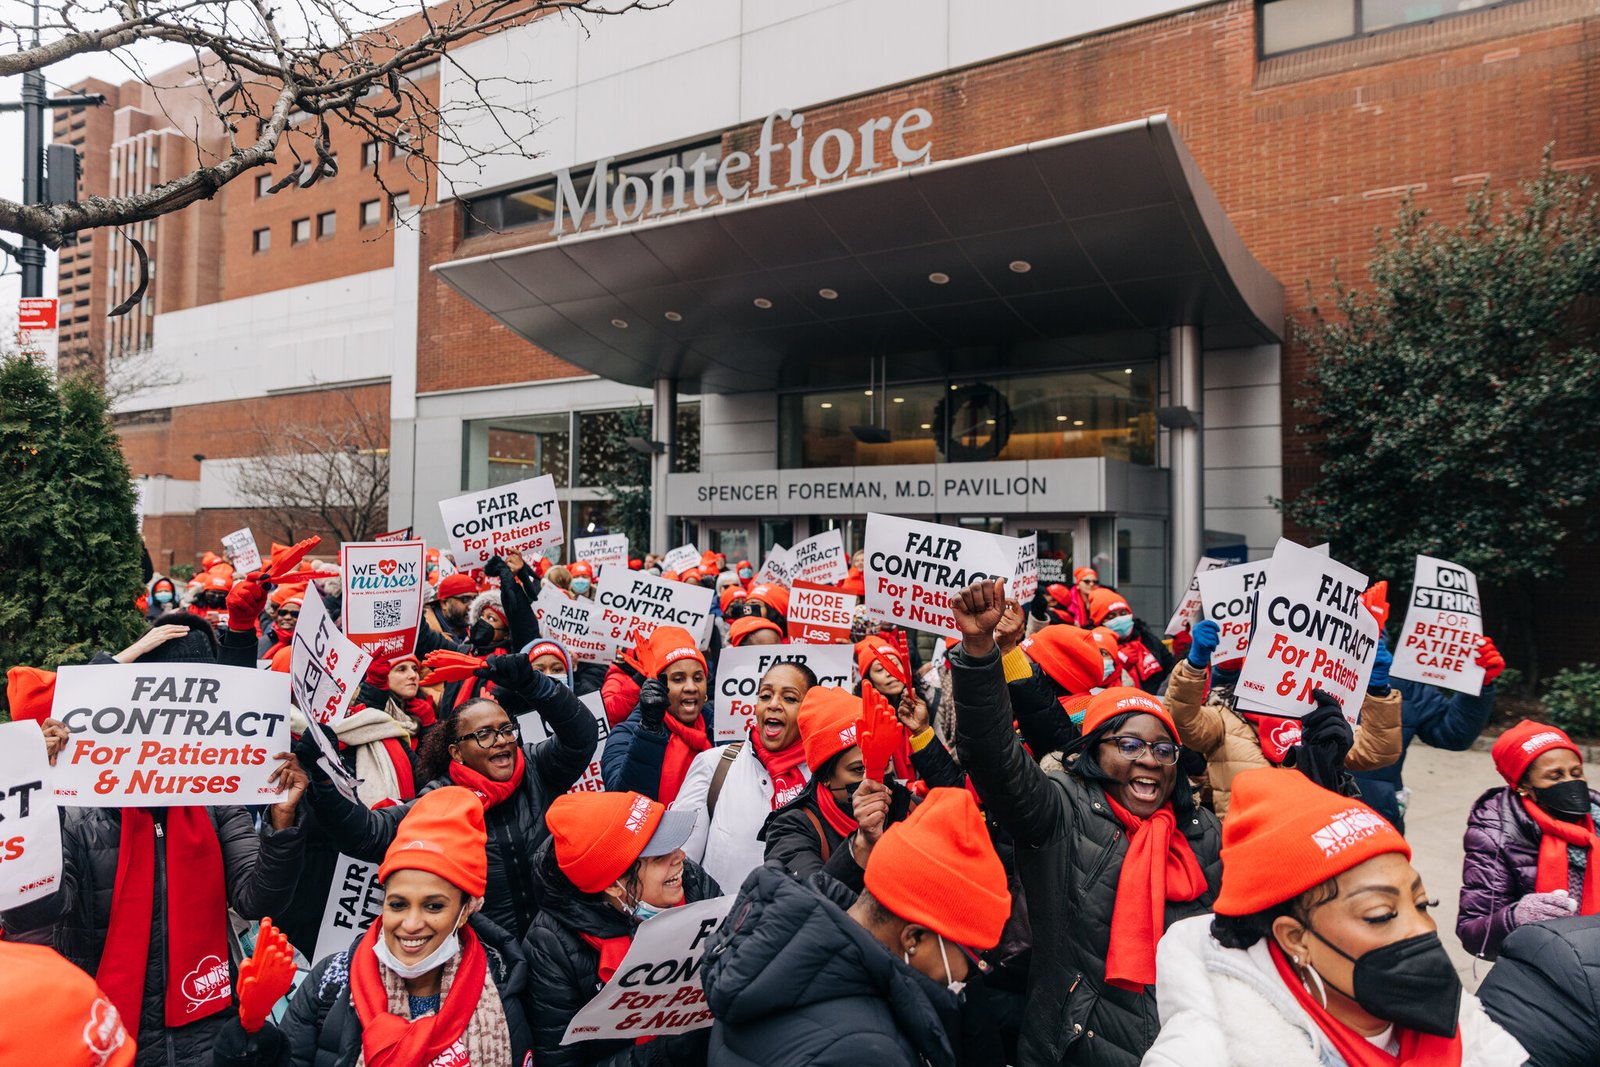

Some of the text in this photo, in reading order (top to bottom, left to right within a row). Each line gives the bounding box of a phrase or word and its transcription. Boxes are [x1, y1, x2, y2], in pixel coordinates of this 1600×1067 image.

[548, 108, 933, 236] Montefiore
[697, 476, 1047, 501] SPENCER FOREMAN, M.D. PAVILION
[476, 492, 519, 515] FAIR
[452, 500, 555, 538] CONTRACT
[463, 537, 489, 552] For
[491, 520, 551, 544] Patients
[589, 540, 608, 548] FAIR
[905, 532, 962, 562] FAIR
[479, 550, 490, 562] &
[578, 545, 624, 558] CONTRACT
[796, 542, 818, 559] FAIR
[352, 561, 417, 576] WE NY
[1437, 568, 1468, 591] ON
[350, 573, 418, 590] nurses
[630, 580, 673, 603] FAIR
[1243, 570, 1267, 592] FA
[798, 591, 844, 609] MORE
[878, 577, 953, 609] For Pati
[1415, 587, 1481, 615] STRIKE
[560, 604, 590, 622] FAIR
[600, 591, 704, 627] CONTRACT
[790, 605, 850, 625] NURSES
[892, 600, 962, 632] & Nurs
[1437, 611, 1469, 629] FOR
[545, 614, 590, 636] CONTR
[602, 609, 658, 633] For Pati
[610, 626, 621, 639] &
[1222, 622, 1252, 637] For
[1268, 596, 1375, 664] CONTRACT
[561, 633, 606, 652] Patients
[802, 624, 831, 642] Less
[1236, 636, 1248, 651] &
[1267, 633, 1359, 692] For Patients
[1415, 653, 1465, 673] CARE
[131, 676, 221, 704] FAIR
[1276, 670, 1297, 697] &
[61, 706, 285, 738] CONTRACT
[71, 740, 267, 765] For Patients
[93, 769, 241, 795] & Nurses
[333, 864, 369, 930] FAIR
[193, 967, 230, 992] NURS
[196, 976, 230, 997] ASSOCIA
[608, 991, 667, 1011] For
[615, 1008, 716, 1031] & Nurs
